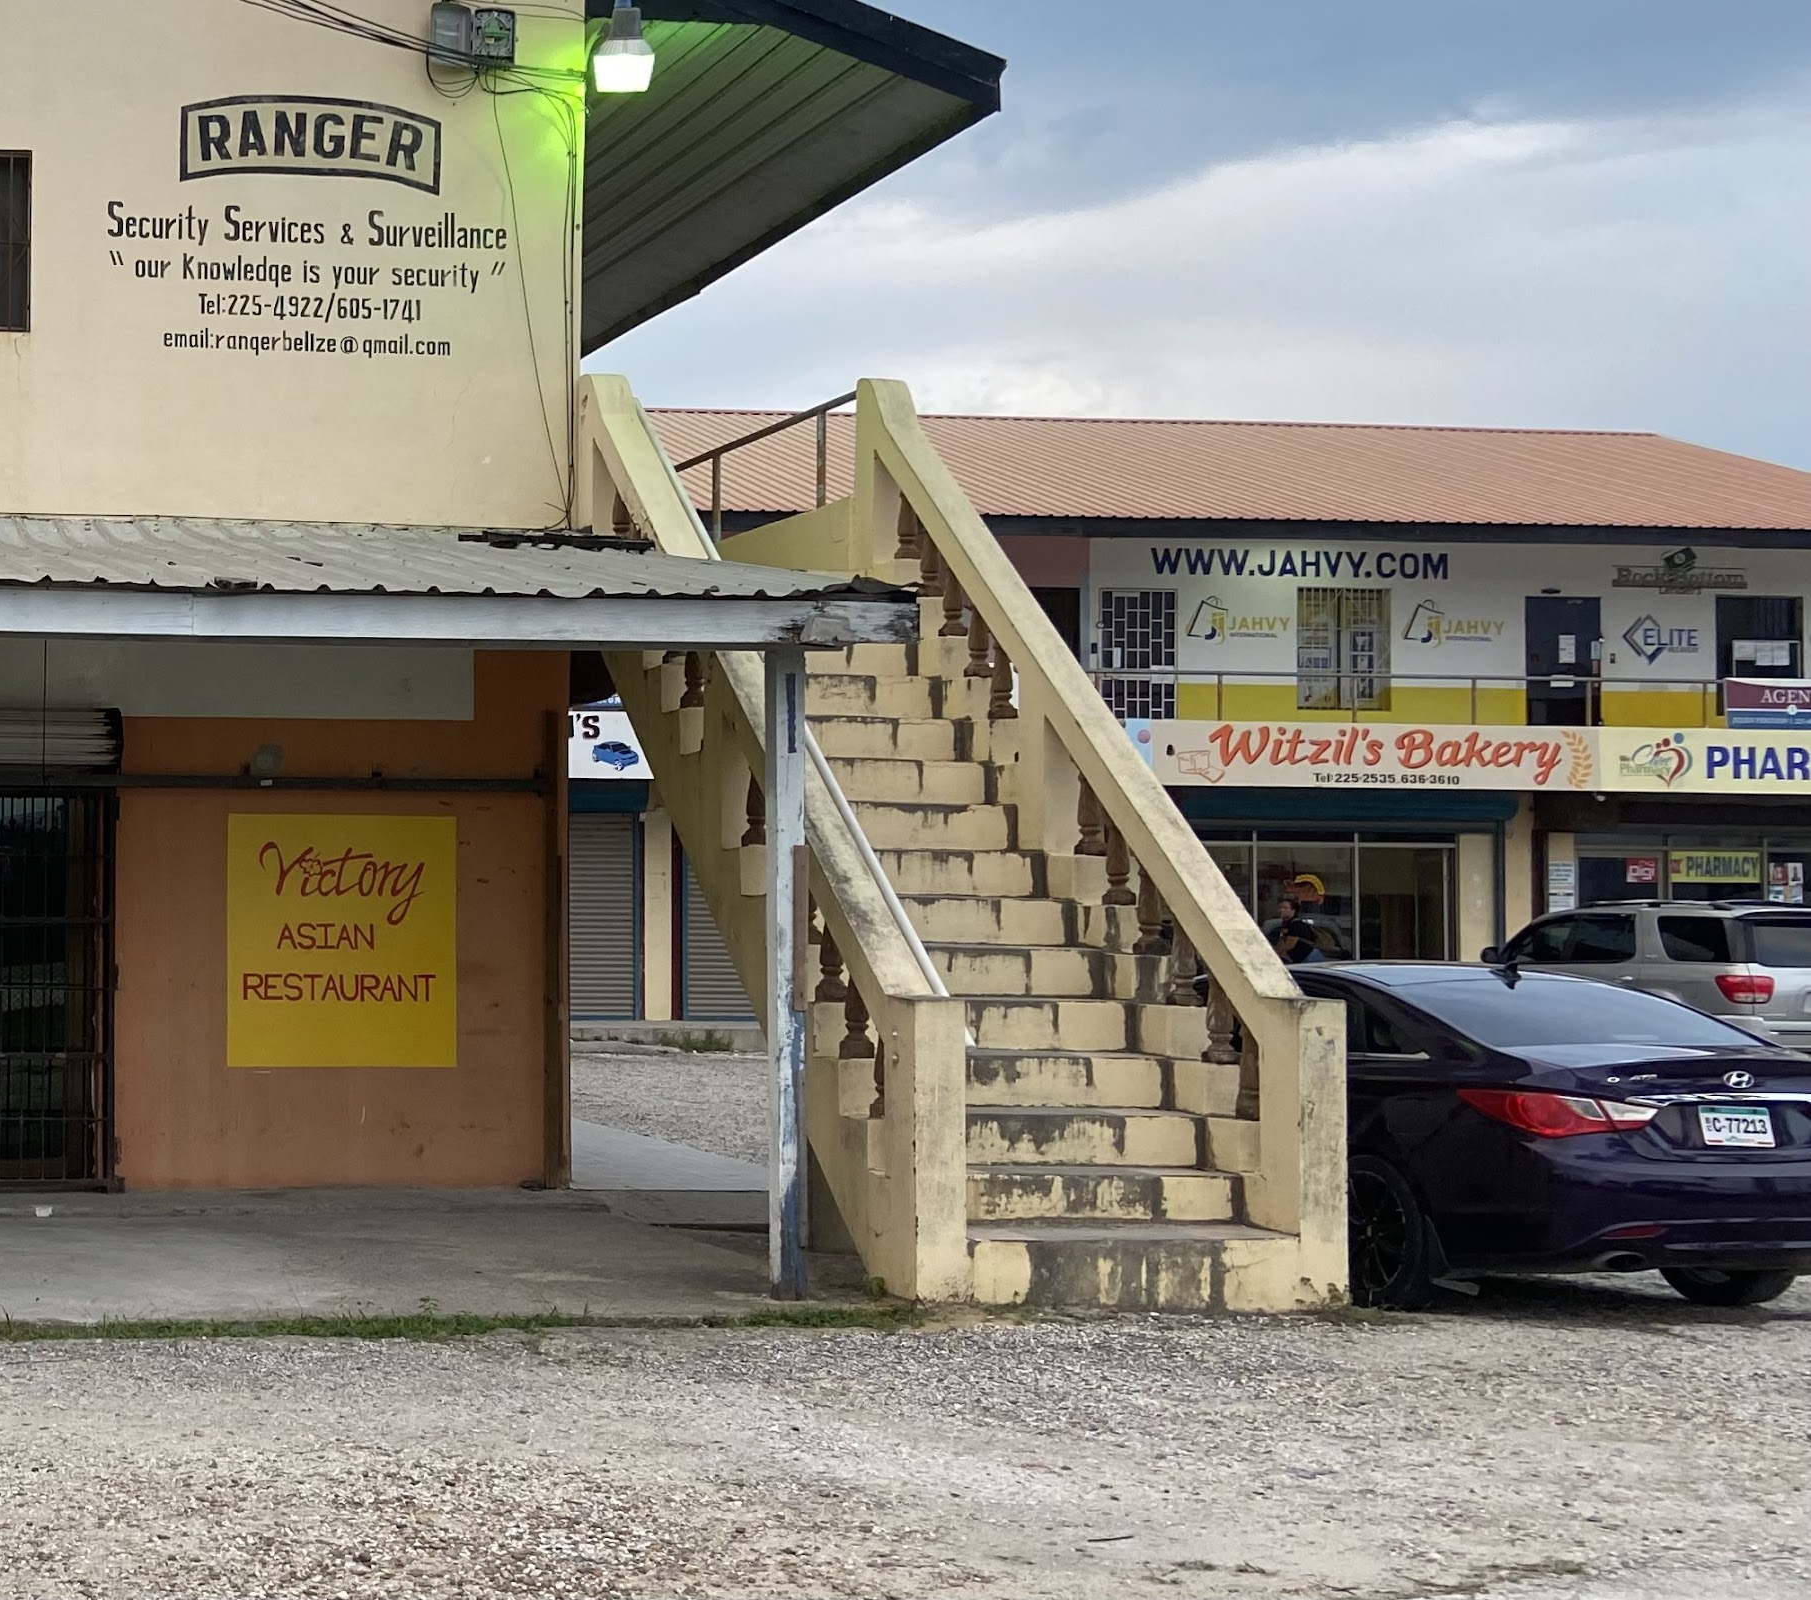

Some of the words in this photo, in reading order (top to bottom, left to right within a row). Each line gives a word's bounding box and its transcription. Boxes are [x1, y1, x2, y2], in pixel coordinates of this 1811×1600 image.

[197, 109, 423, 172] RANGER
[107, 200, 209, 246] Security
[224, 205, 325, 244] Services
[340, 223, 354, 246] &
[368, 209, 507, 250] Surveillance
[135, 258, 171, 279] our
[182, 253, 292, 288] Knowledge
[303, 260, 321, 284] is
[333, 265, 380, 290] your
[391, 262, 479, 294] security
[198, 293, 421, 323] Tel:225-4922/605-1741
[1150, 547, 1449, 580] WWW.JAHVY.COM
[1228, 616, 1291, 632] JAHVY
[1443, 619, 1505, 635] JAHVY
[1643, 628, 1699, 647] ELITE
[1209, 723, 1383, 768] Witzil's
[1394, 728, 1563, 786] Bakery
[1705, 745, 1811, 781] PHAR
[1685, 856, 1759, 878] PHARMACY
[259, 841, 426, 926] Victory
[277, 922, 375, 951] ASIAN
[242, 972, 437, 1002] RESTAURANT
[1712, 1117, 1768, 1135] C-77213
